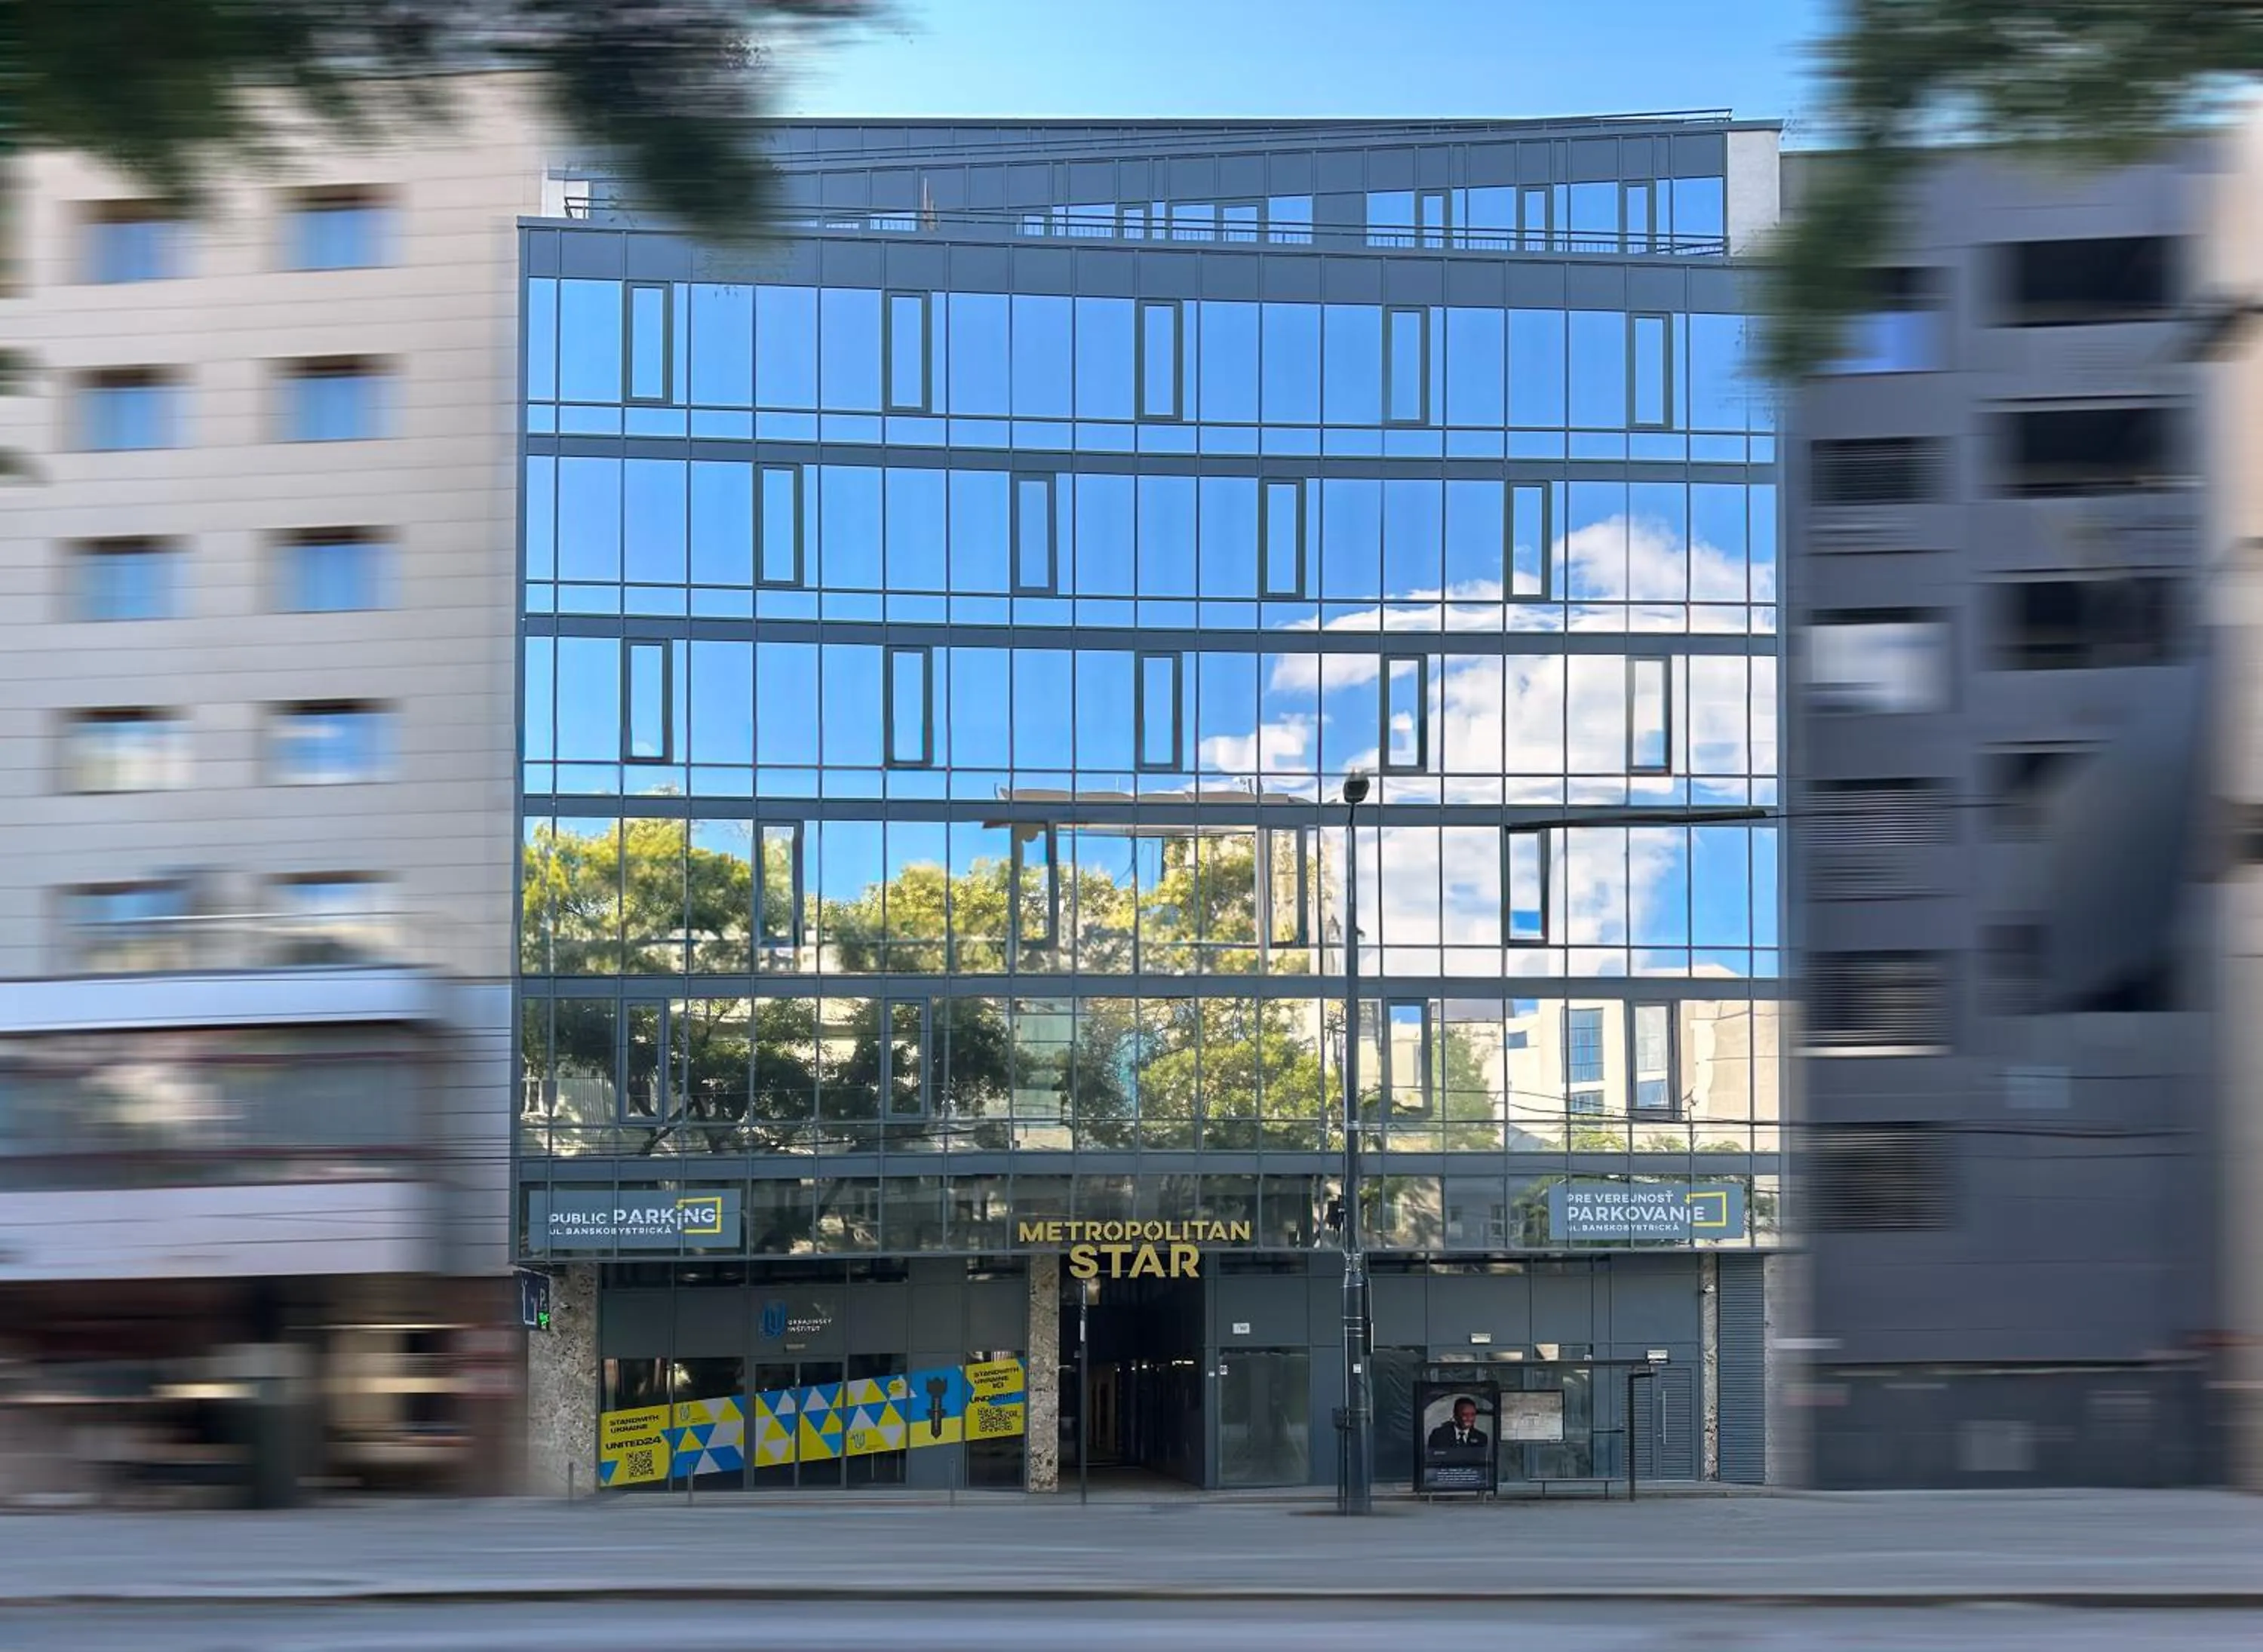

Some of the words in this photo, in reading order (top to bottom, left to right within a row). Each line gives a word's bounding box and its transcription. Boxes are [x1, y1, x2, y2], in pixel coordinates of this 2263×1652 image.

[1568, 1193, 1592, 1203] PRE
[549, 1213, 607, 1224] PUBLIC
[1018, 1220, 1251, 1242] METROPOLITAN
[1069, 1244, 1200, 1279] STAR
[606, 1436, 661, 1450] UNITED24
